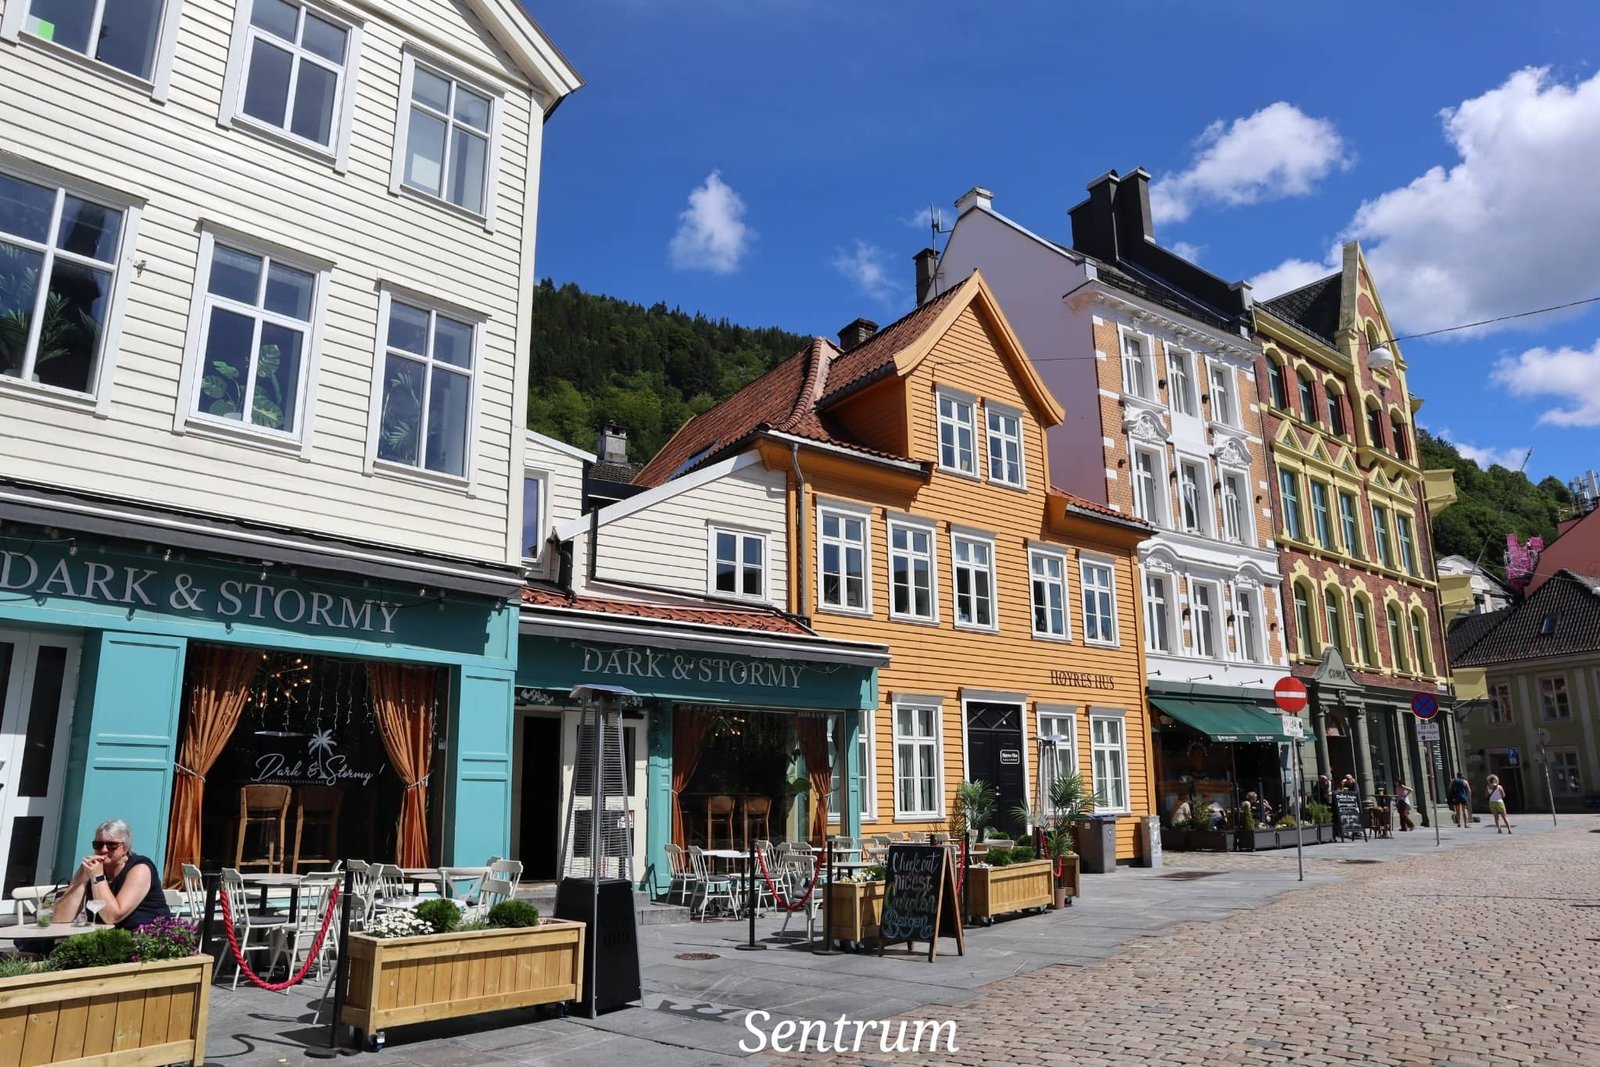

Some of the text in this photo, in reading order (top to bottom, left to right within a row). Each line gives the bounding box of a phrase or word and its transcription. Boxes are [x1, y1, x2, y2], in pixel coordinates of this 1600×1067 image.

[0, 550, 403, 634] DARK & STORMY
[581, 647, 804, 689] DARK & STORMY
[1095, 674, 1115, 690] HUS
[250, 753, 374, 786] Dark & Stormy
